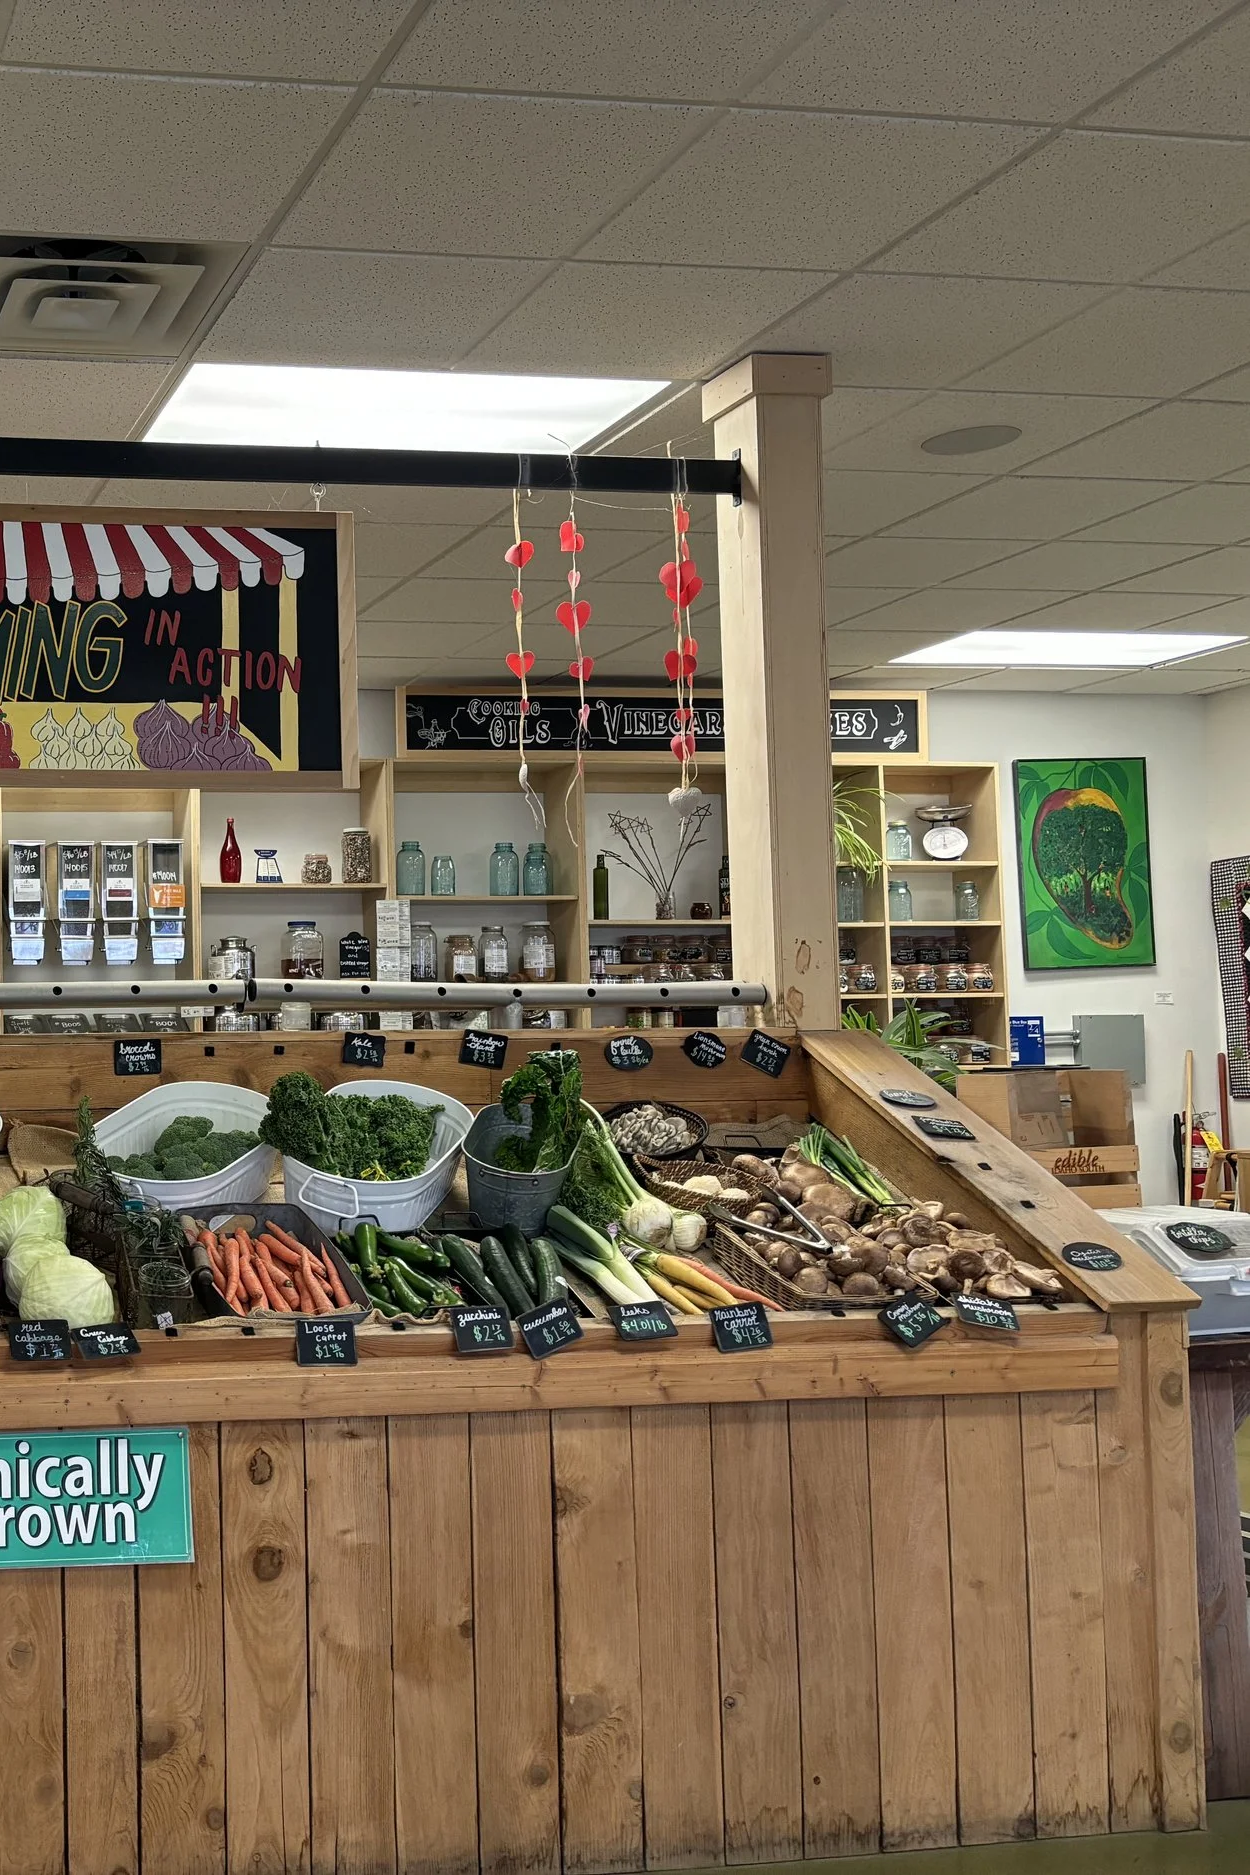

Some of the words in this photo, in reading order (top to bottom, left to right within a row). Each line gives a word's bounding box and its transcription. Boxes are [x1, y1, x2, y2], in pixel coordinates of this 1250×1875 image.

[144, 608, 181, 648] IN
[168, 648, 303, 695] ACTION
[596, 700, 724, 744] VINEGAR
[830, 712, 867, 736] ES
[119, 1041, 156, 1054] broccoli
[351, 1037, 373, 1048] Kale
[1054, 1149, 1099, 1168] edible
[457, 1308, 501, 1327] zucchini
[21, 1322, 45, 1332] red
[304, 1322, 334, 1333] Loose
[15, 1333, 62, 1344] cabbage
[316, 1332, 347, 1342] carrot
